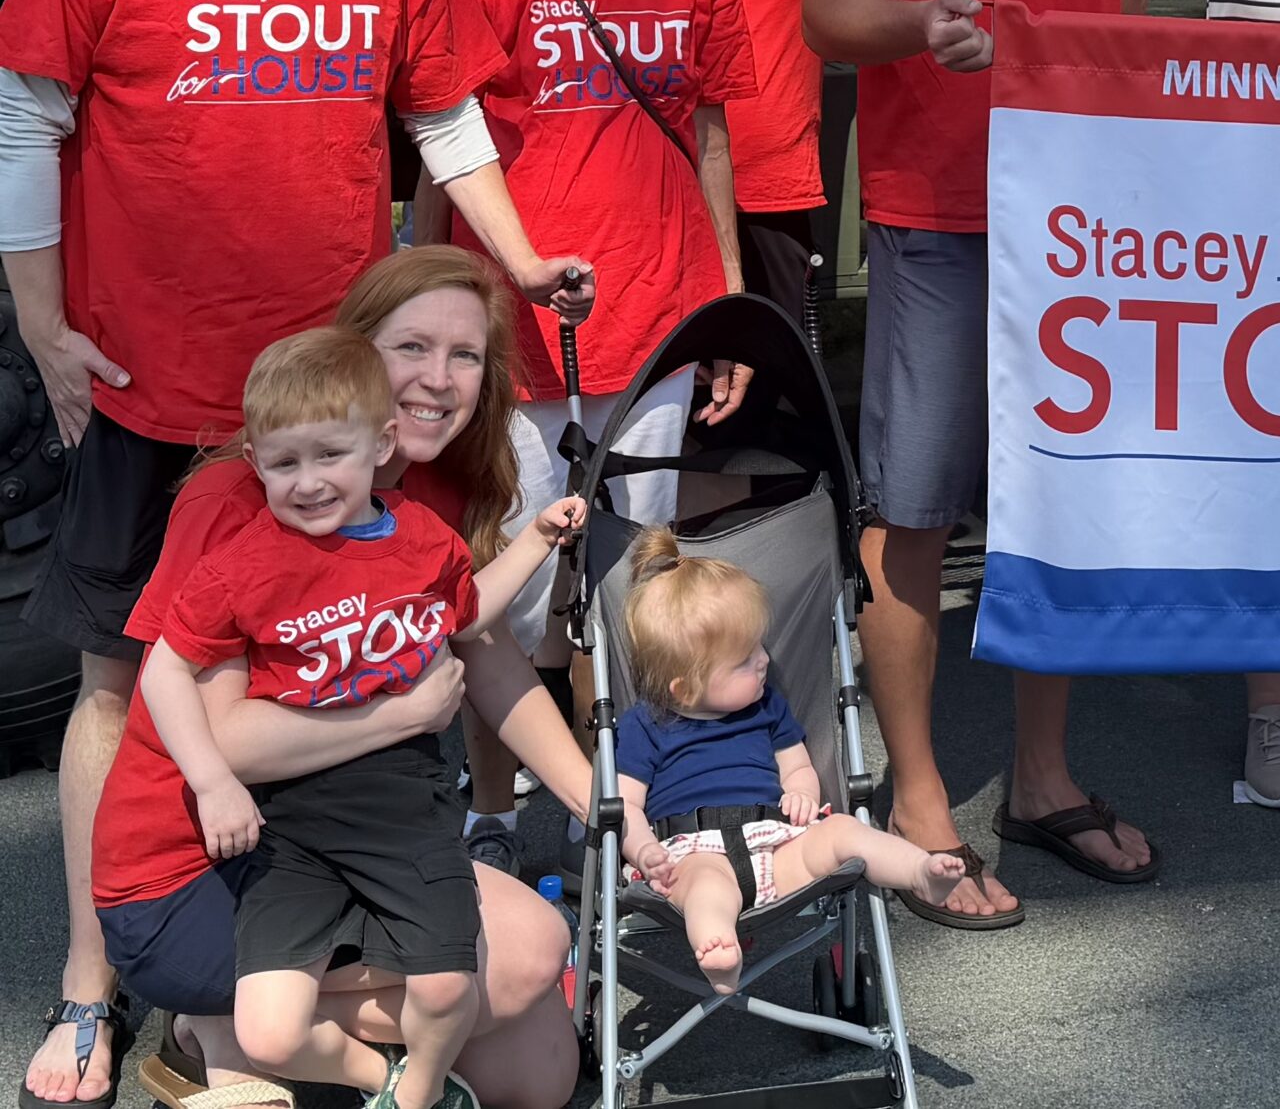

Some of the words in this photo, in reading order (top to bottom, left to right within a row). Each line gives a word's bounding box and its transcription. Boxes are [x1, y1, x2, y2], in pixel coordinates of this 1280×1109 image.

[186, 4, 380, 52] STOUT
[534, 20, 689, 68] STOUT
[167, 61, 213, 102] for
[212, 54, 375, 95] HOUSE
[1046, 204, 1269, 299] Stacey
[276, 593, 366, 643] Stacey
